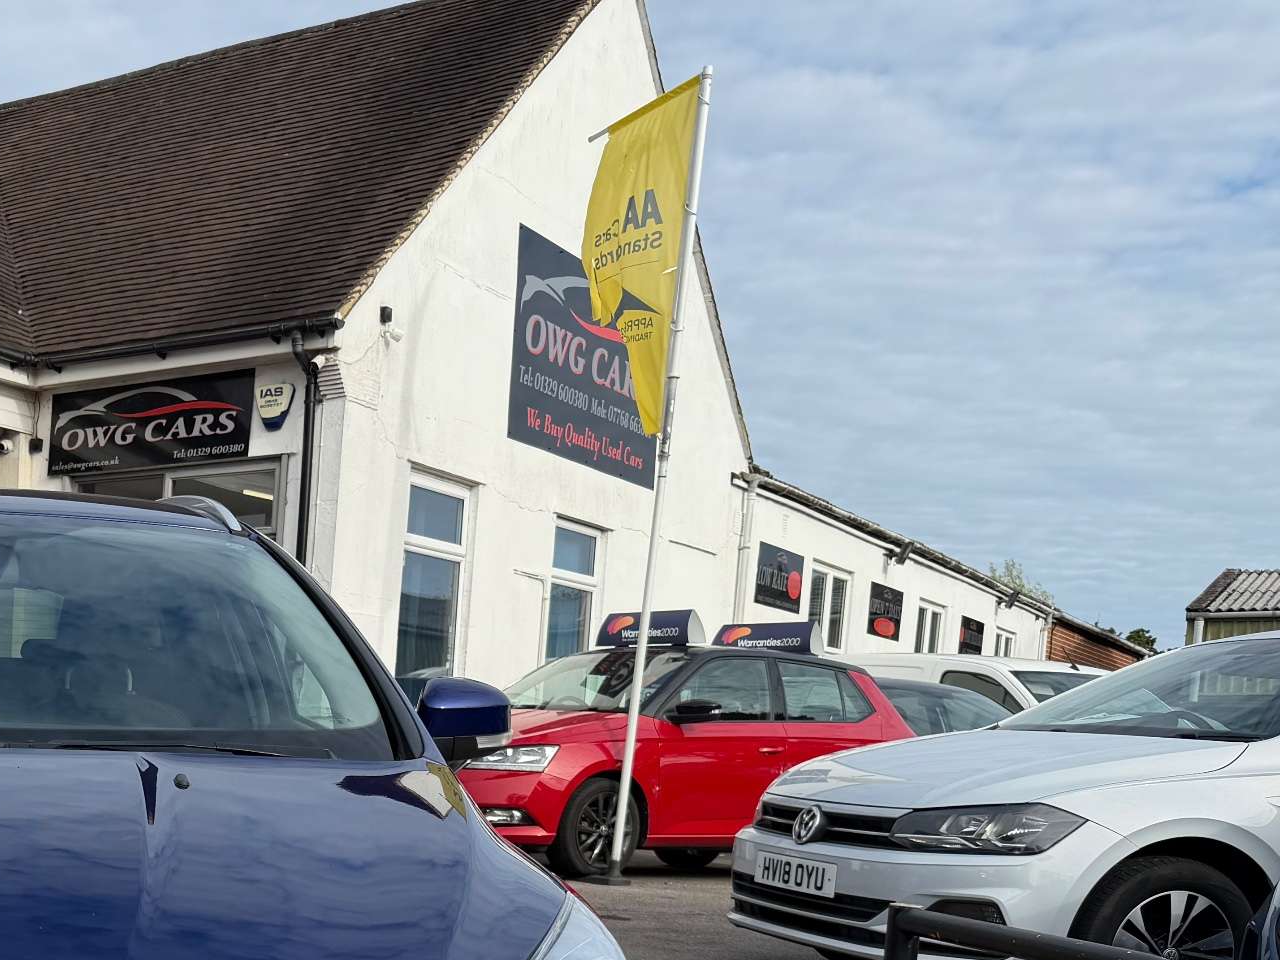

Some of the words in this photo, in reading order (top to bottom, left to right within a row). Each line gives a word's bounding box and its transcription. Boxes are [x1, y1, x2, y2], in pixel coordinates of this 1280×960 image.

[524, 314, 586, 375] OWG
[260, 386, 284, 399] IAS
[534, 372, 558, 398] 01329
[558, 383, 588, 411] 600380
[607, 405, 629, 429] 07768
[61, 423, 137, 451] OWG
[144, 411, 238, 443] CARS
[527, 406, 541, 431] We
[543, 414, 564, 448] Buy
[565, 422, 600, 461] Quality
[601, 436, 623, 461] Used
[624, 446, 644, 470] Cars
[187, 447, 211, 458] 01329
[211, 443, 245, 455] 600380
[757, 564, 772, 587] LOW
[737, 637, 801, 648] Warranties2000
[762, 856, 792, 885] HV18
[794, 863, 826, 892] OYU
